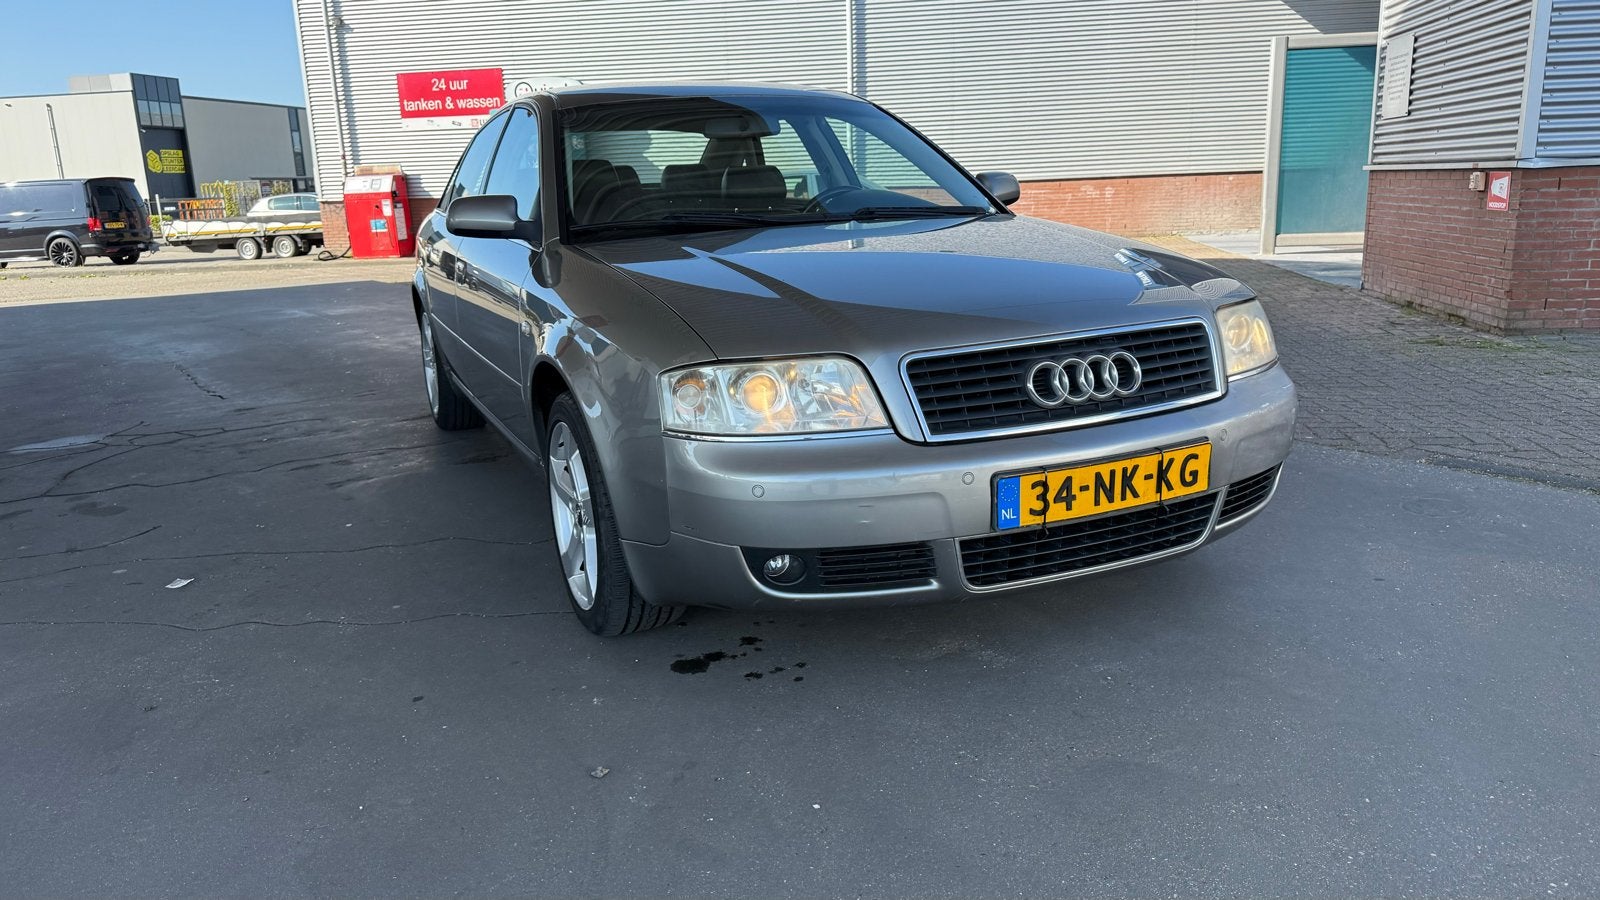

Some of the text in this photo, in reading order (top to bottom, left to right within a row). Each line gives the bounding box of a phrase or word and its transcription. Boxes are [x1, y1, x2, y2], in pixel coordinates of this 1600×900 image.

[431, 78, 468, 92] 24 uur
[403, 96, 501, 112] tanken & wassen
[1001, 453, 1199, 520] NL 34-NK-KG
